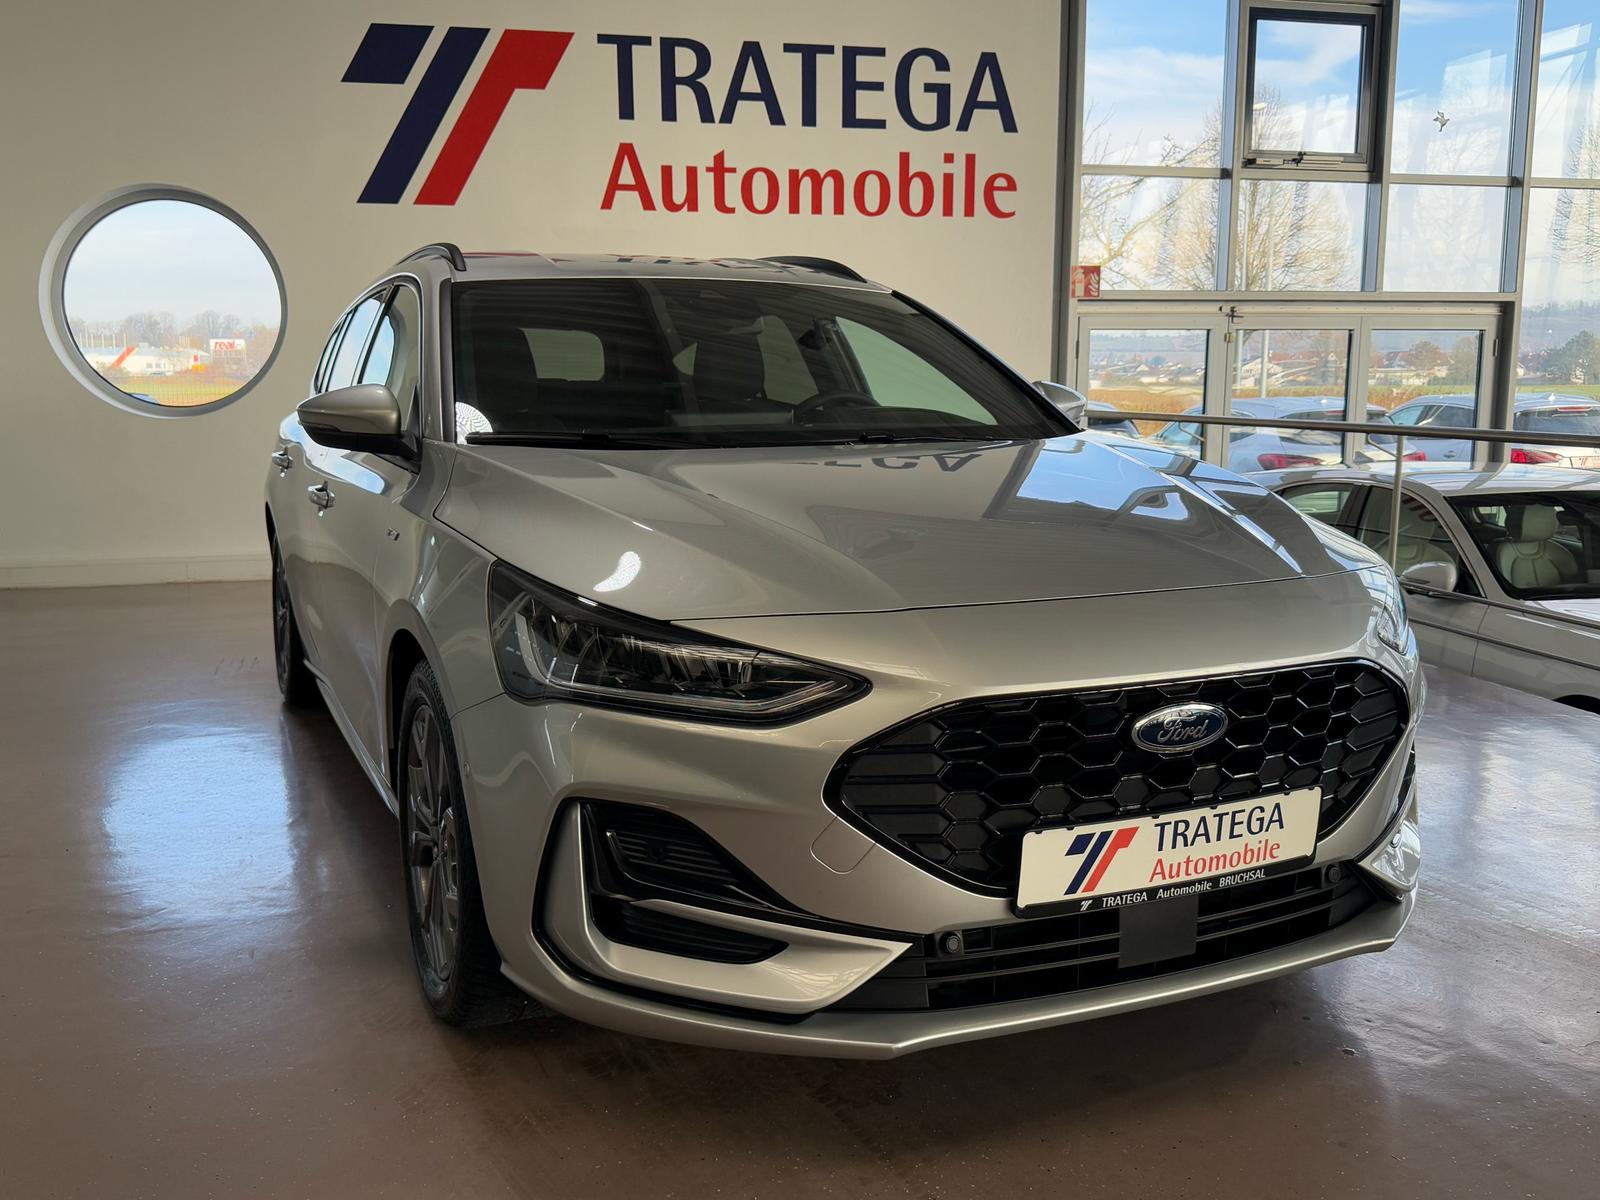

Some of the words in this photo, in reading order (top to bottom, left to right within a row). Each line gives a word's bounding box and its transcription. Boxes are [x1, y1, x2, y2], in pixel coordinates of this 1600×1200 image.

[597, 34, 1018, 133] TRATEGA
[601, 143, 1018, 219] Automobile
[1157, 715, 1209, 743] Ford
[1153, 802, 1285, 852] TRATEGA
[1149, 838, 1281, 883] Automobile
[1101, 891, 1148, 909] TRATEGA
[1156, 880, 1213, 900] Automobile
[1219, 868, 1266, 888] BRUCHSAL
